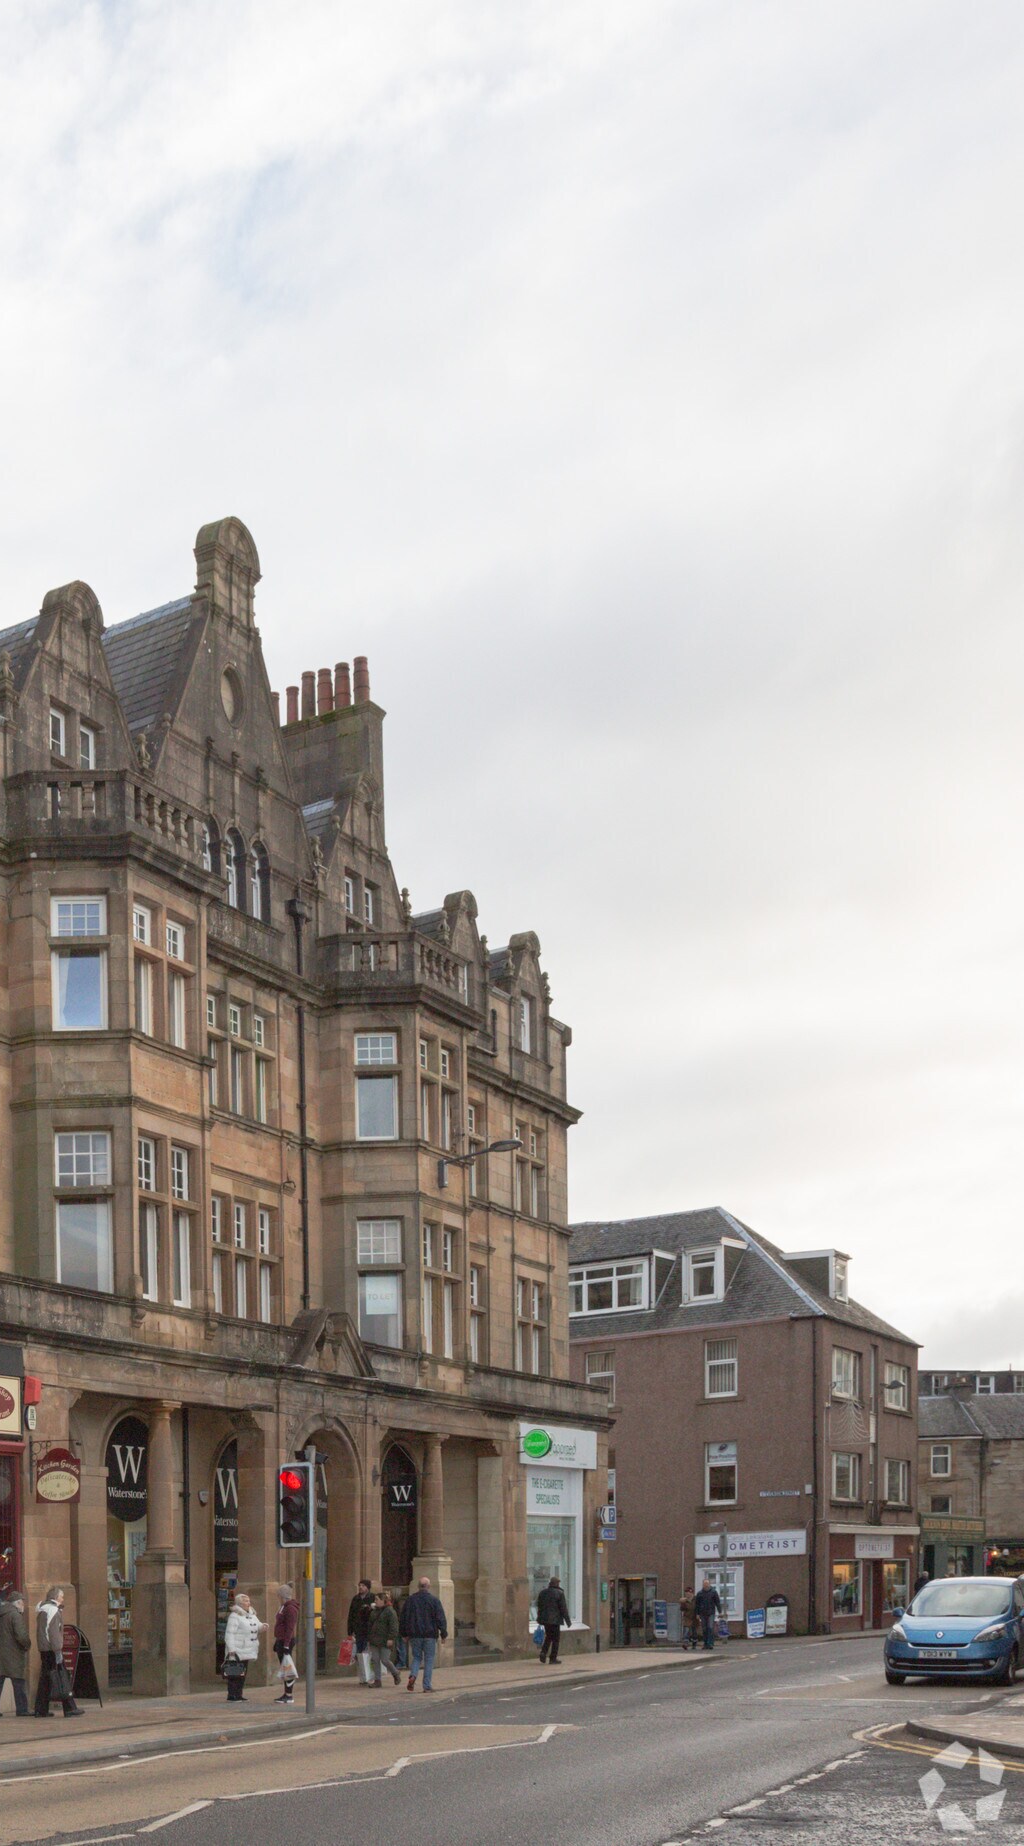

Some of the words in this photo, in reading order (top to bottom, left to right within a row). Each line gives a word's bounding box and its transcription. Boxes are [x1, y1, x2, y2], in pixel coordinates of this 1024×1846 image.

[38, 1461, 59, 1475] Kitchen
[60, 1459, 79, 1475] Garden
[112, 1444, 146, 1484] W
[108, 1486, 147, 1499] Waterstone'
[392, 1485, 412, 1502] W
[536, 1493, 560, 1505] SPECIALISTS
[214, 1515, 238, 1527] atersto
[703, 1540, 798, 1552] OPOMETRIST
